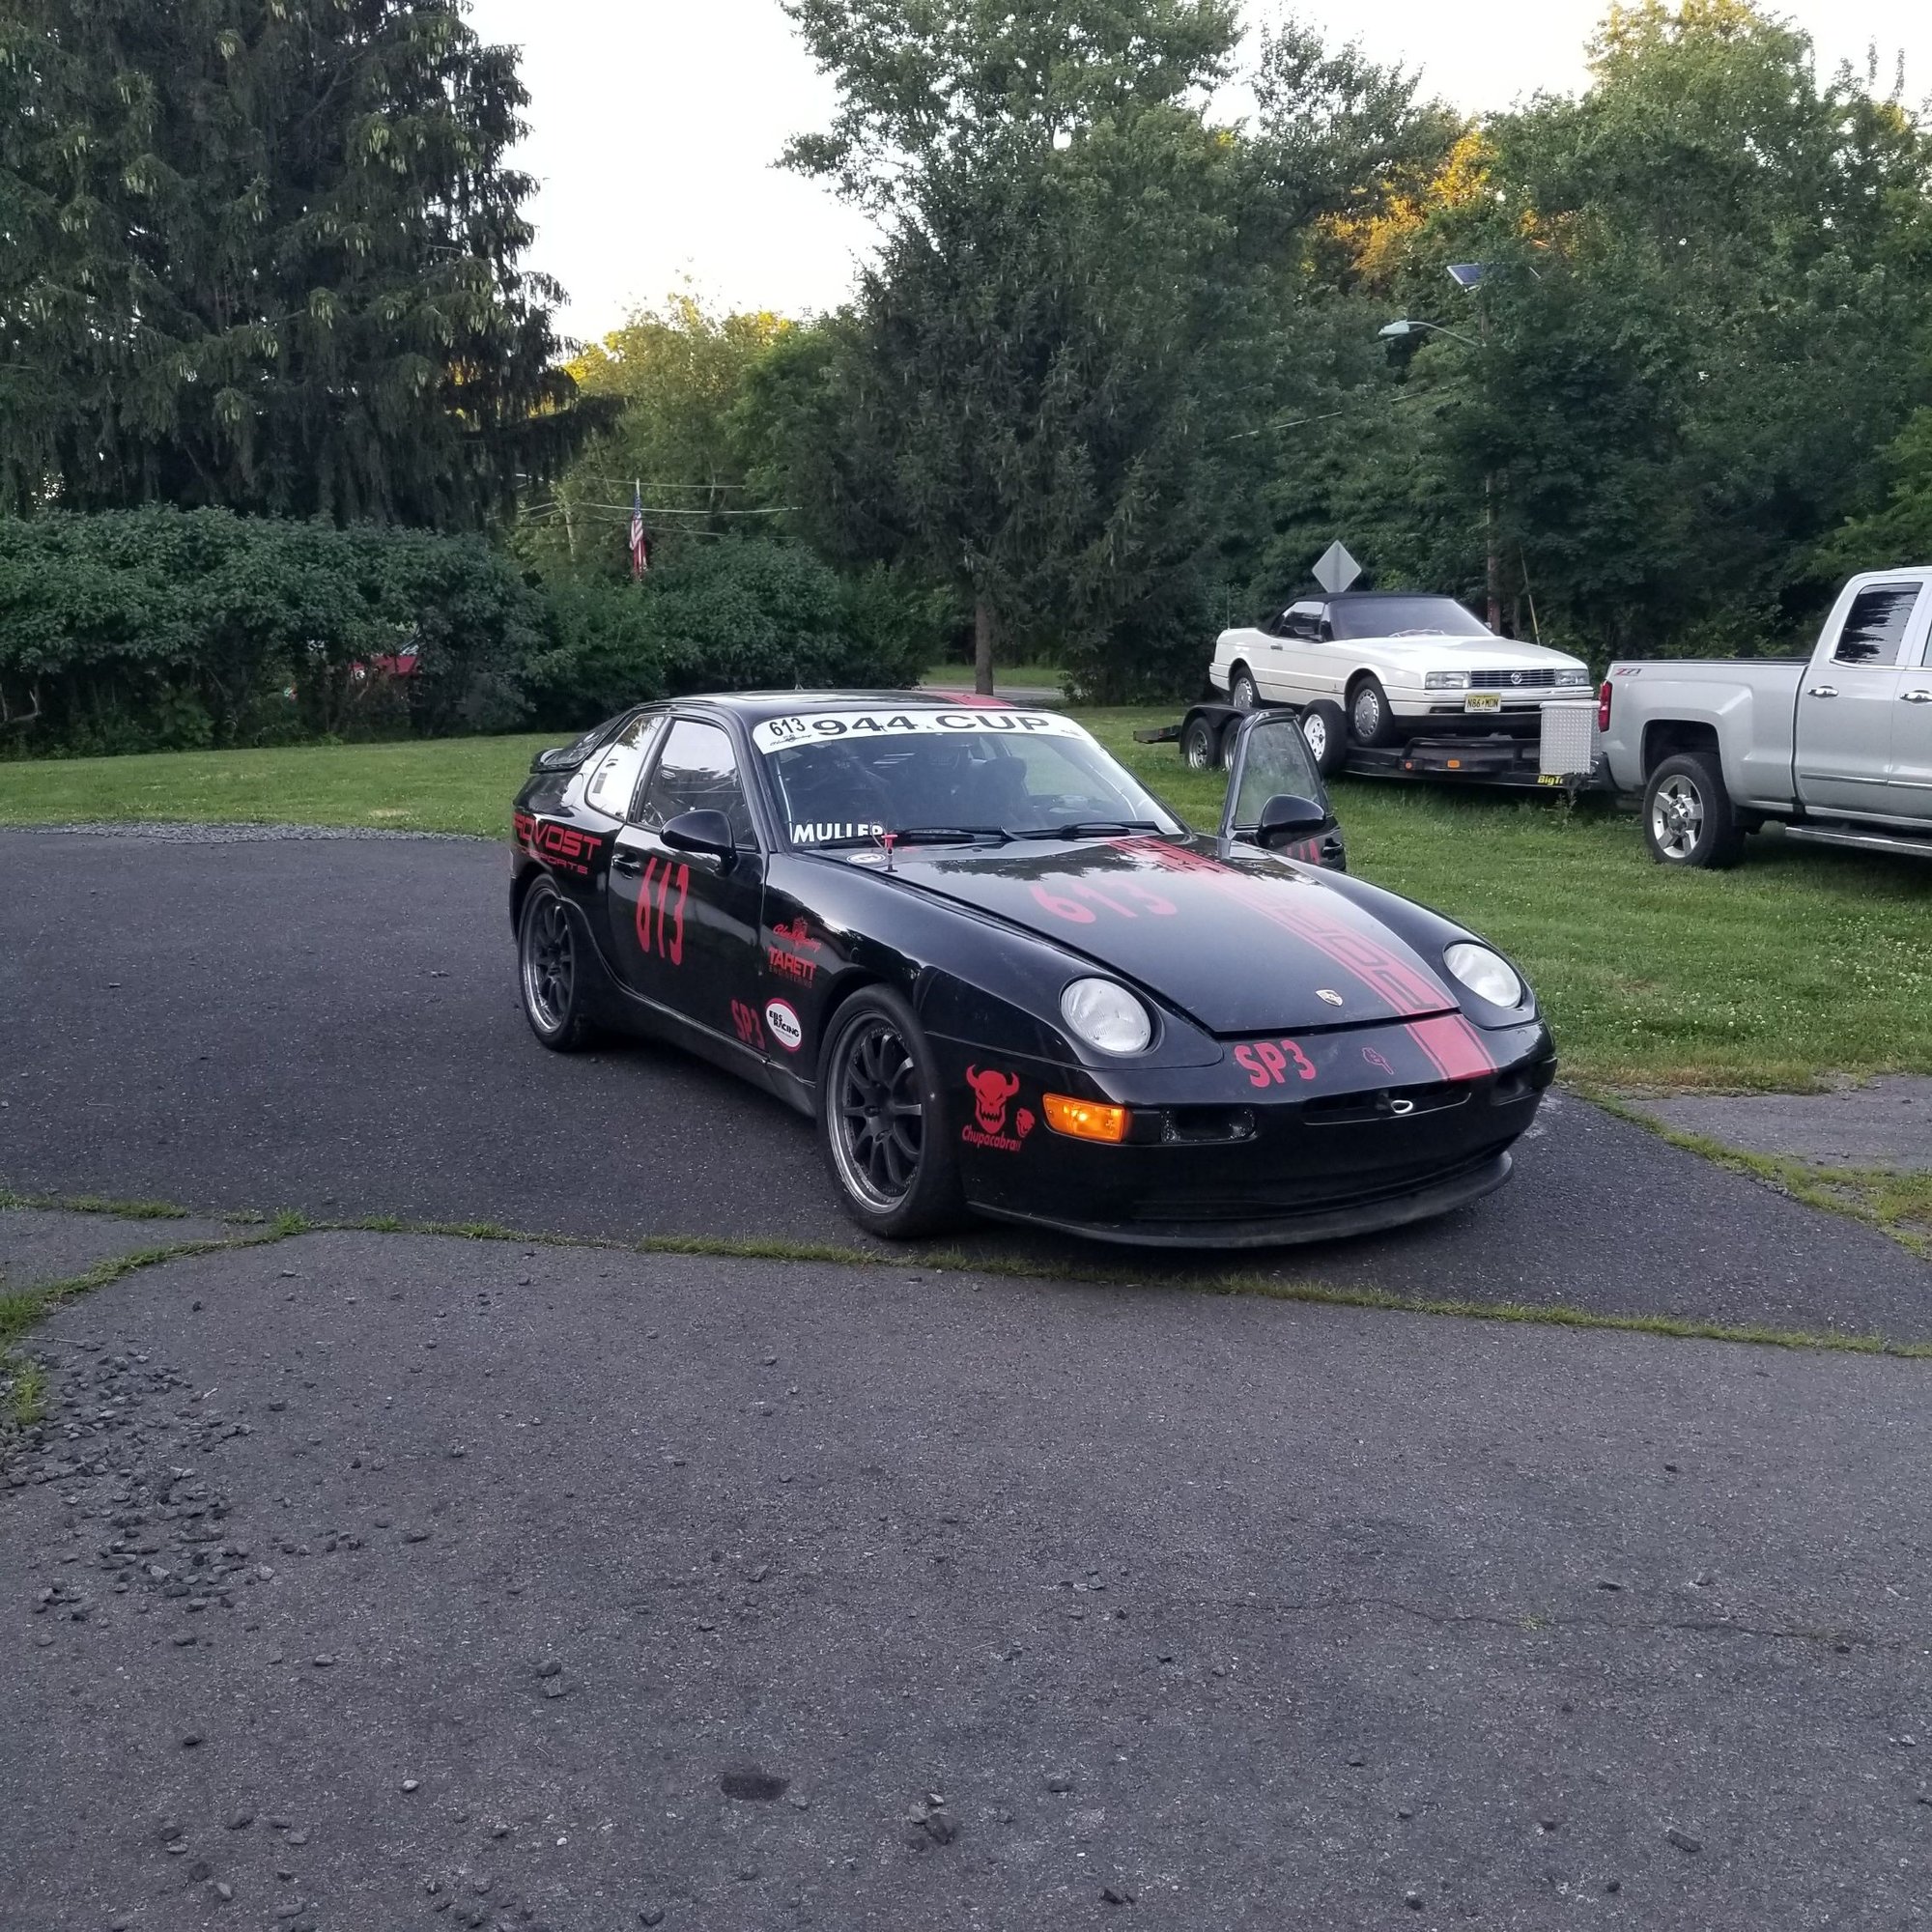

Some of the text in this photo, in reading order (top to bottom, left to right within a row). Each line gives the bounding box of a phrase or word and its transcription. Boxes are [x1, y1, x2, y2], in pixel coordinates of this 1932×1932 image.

[769, 717, 806, 736] 613
[812, 715, 1049, 735] 944 CUP
[635, 857, 689, 965] 613
[1030, 878, 1179, 923] 613
[768, 946, 816, 981] TARETT
[731, 1000, 765, 1050] SP3
[769, 1010, 783, 1022] EBS
[774, 1019, 800, 1037] RACING
[1234, 1039, 1317, 1088] SP3
